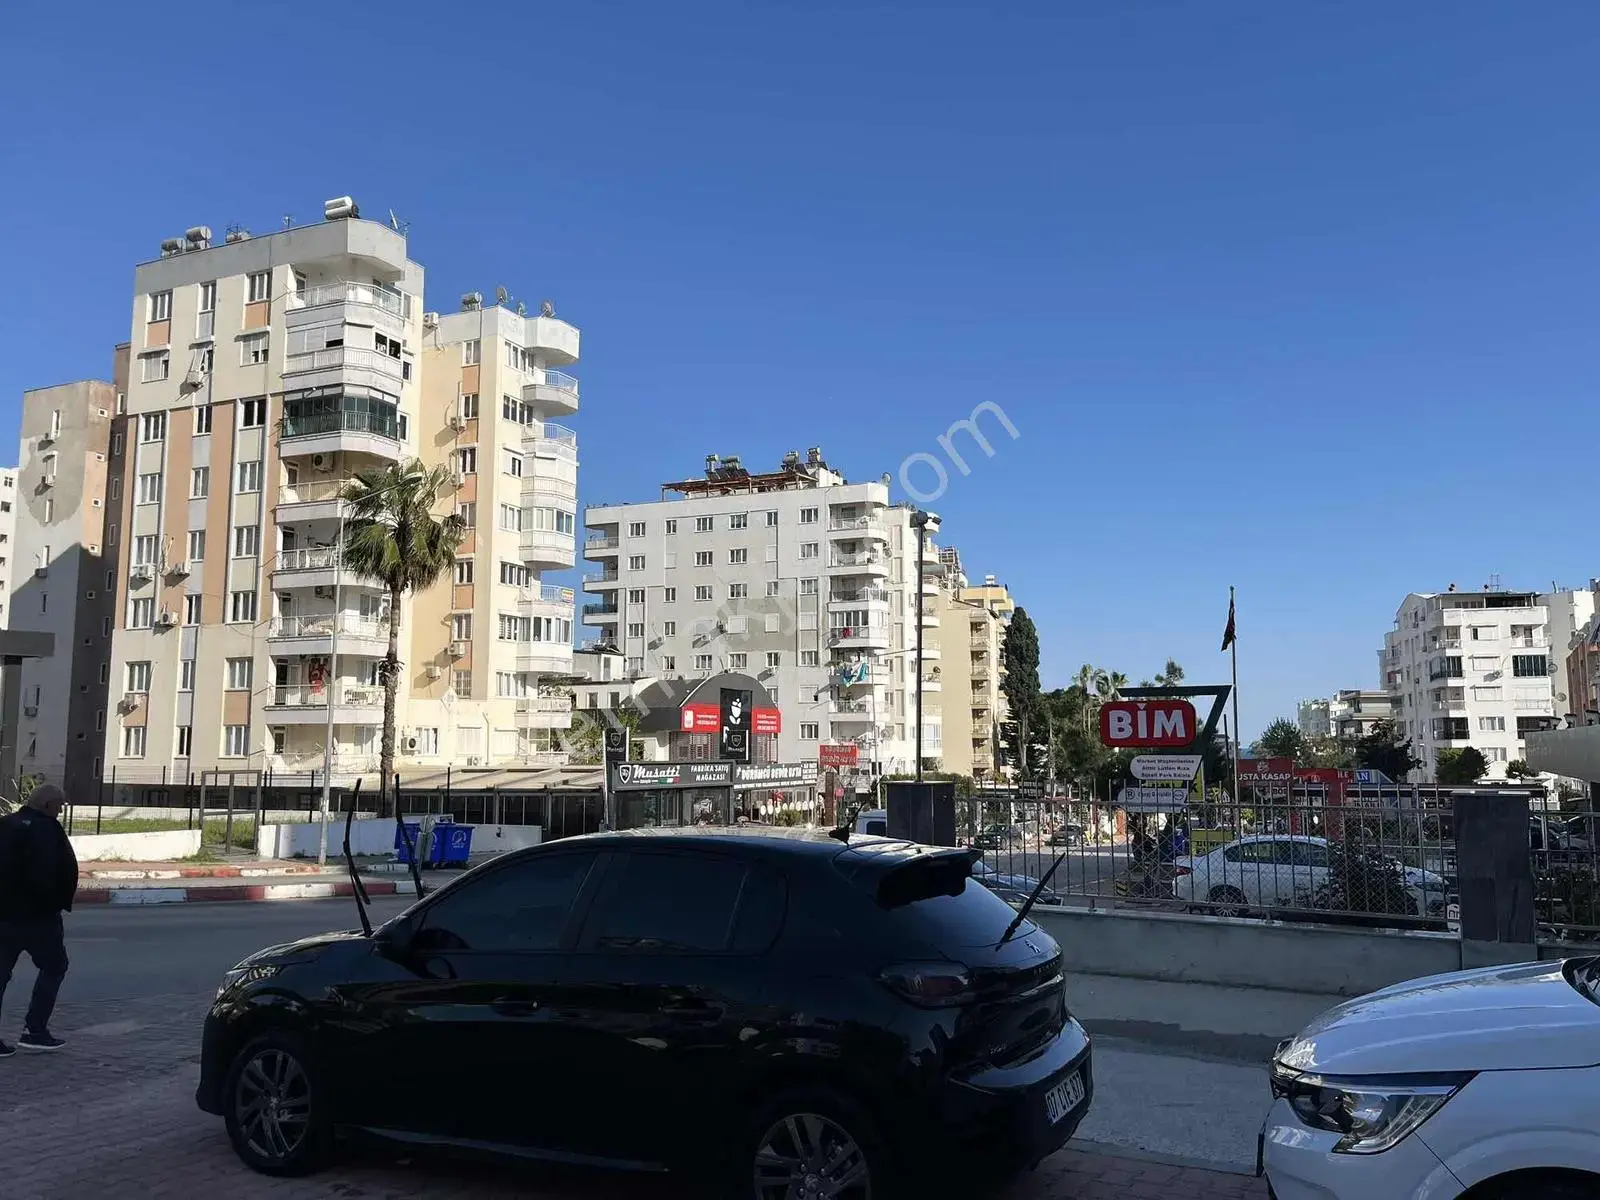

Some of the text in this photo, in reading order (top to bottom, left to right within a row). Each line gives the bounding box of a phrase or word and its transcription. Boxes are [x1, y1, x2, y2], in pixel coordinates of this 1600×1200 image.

[1109, 703, 1186, 738] BİM
[633, 764, 681, 778] Musatti
[690, 764, 713, 774] FABRİKA
[1046, 1092, 1059, 1119] 07
